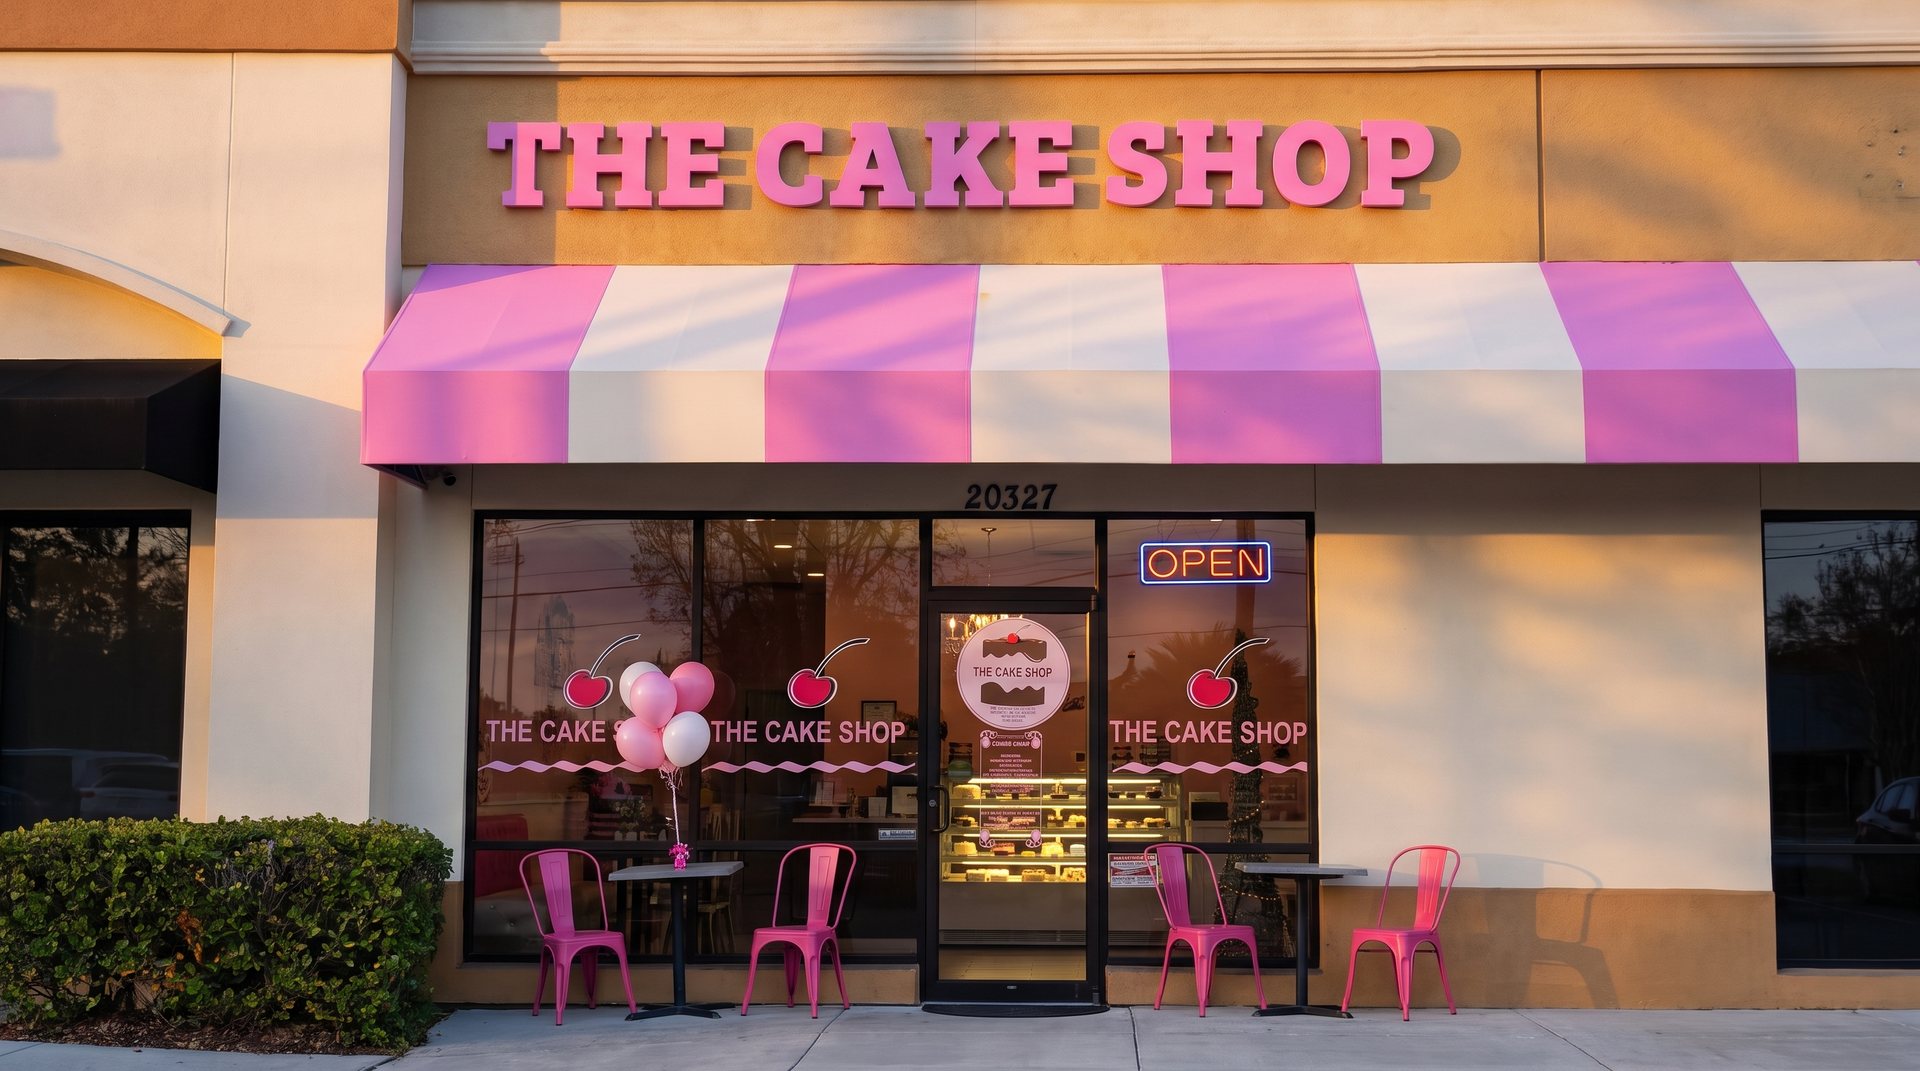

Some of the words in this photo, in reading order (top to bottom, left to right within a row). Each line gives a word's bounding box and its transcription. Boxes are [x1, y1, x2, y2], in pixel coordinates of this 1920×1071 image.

[487, 121, 726, 209] THE
[756, 121, 1075, 209] CAKE
[1106, 120, 1435, 208] SHOP
[965, 484, 1058, 510] 20327
[1148, 548, 1263, 578] OPEN
[973, 667, 993, 677] THE
[995, 667, 1022, 677] CAKE
[1025, 667, 1052, 678] SHOP
[486, 720, 533, 743] THE
[540, 720, 606, 743] CAKE
[711, 720, 758, 743] THE
[765, 720, 832, 744] CAKE
[838, 721, 905, 744] SHOP
[1109, 720, 1157, 743] THE
[1164, 720, 1233, 744] CAKE
[1240, 721, 1307, 745] SHOP
